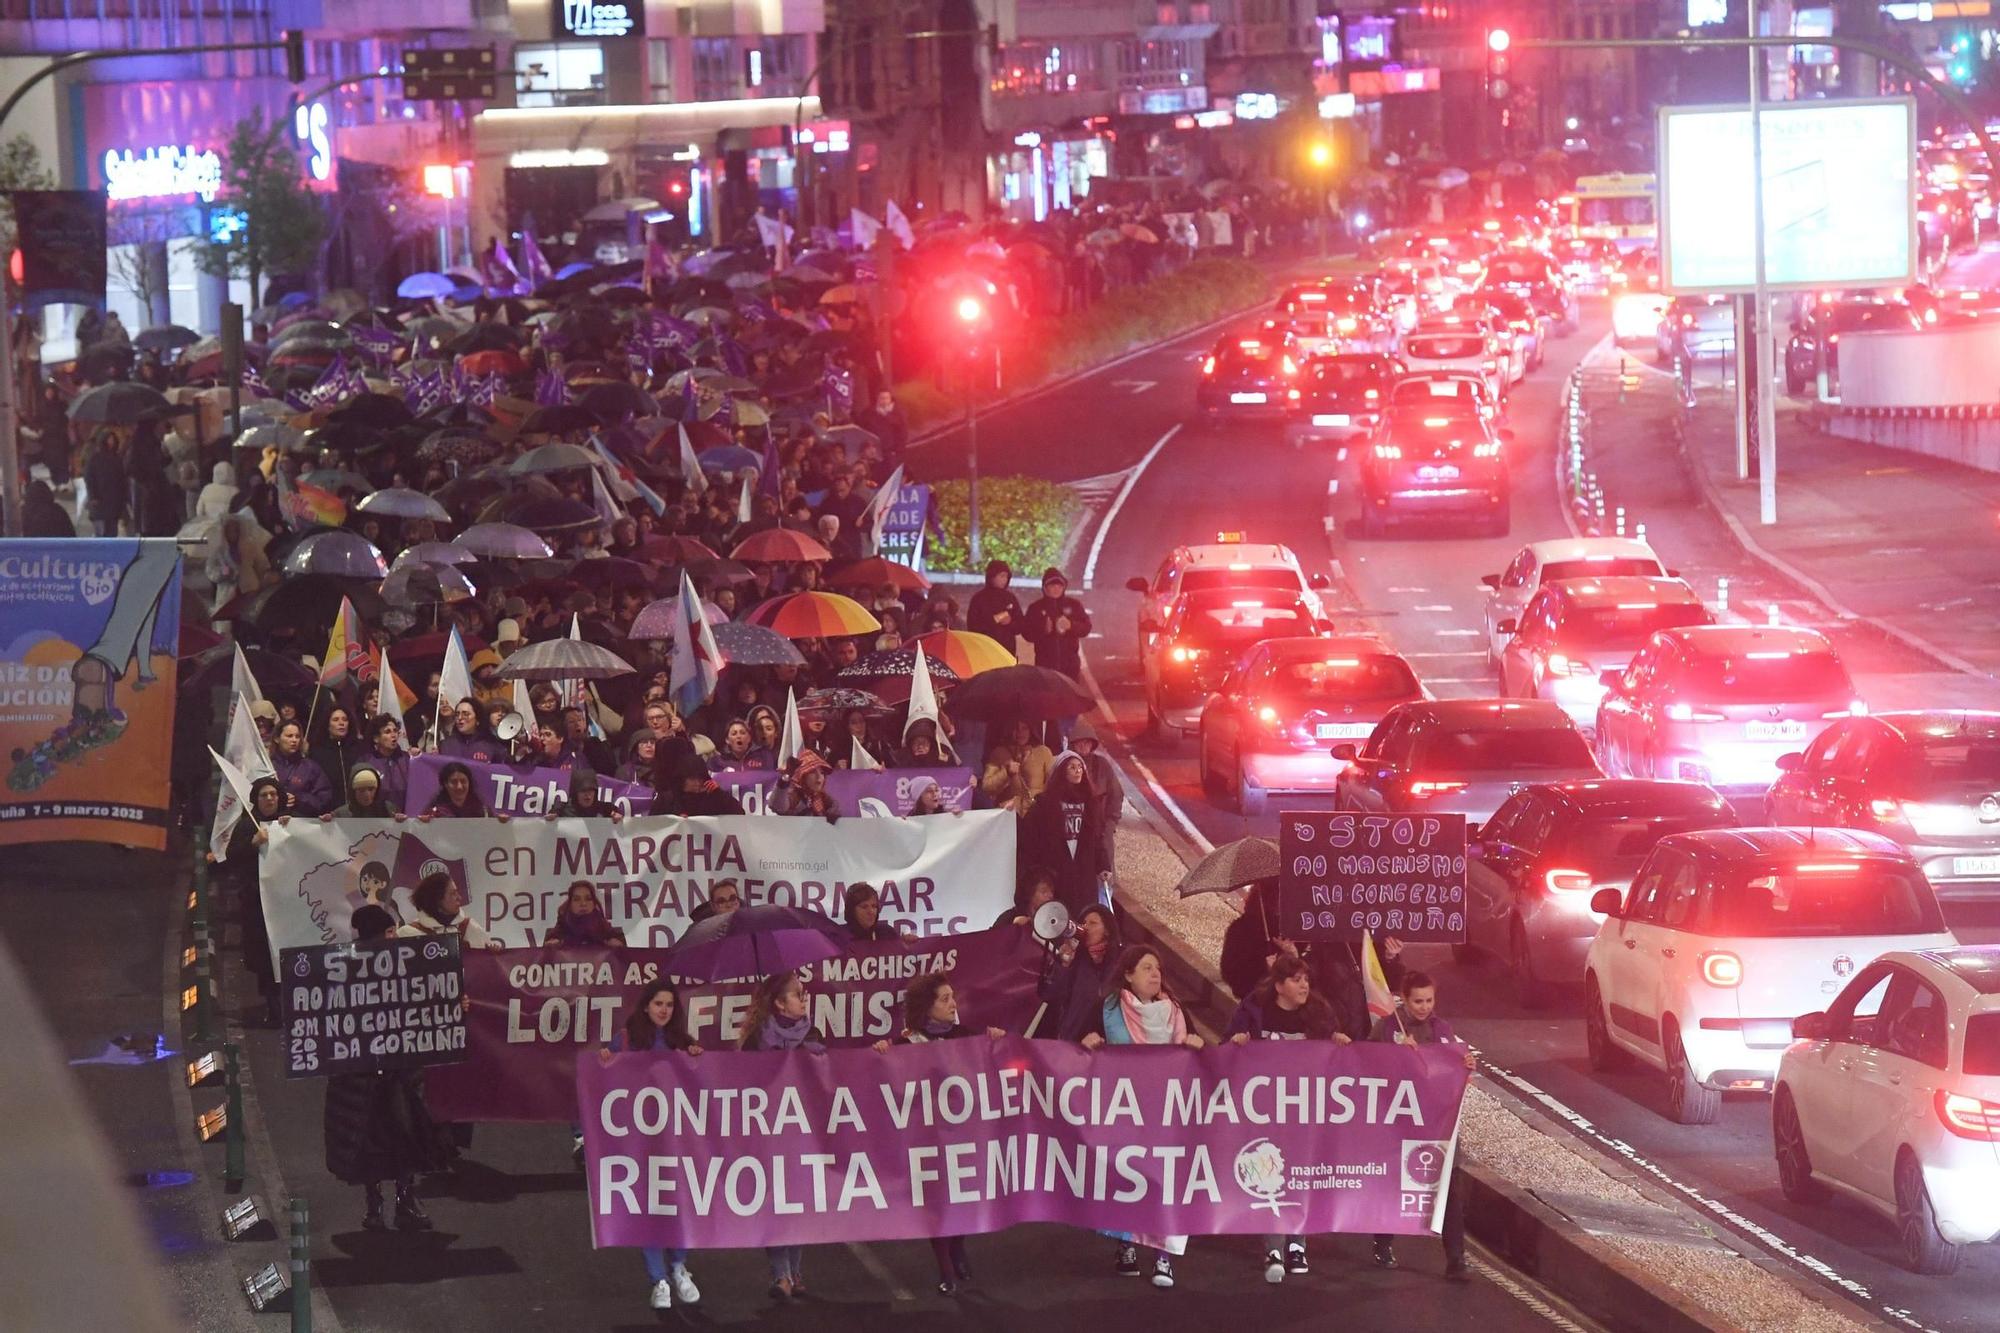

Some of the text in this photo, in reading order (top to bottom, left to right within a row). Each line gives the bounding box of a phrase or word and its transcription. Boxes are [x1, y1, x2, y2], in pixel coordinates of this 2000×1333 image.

[84, 581, 109, 596] bio
[37, 666, 72, 682] DA
[33, 805, 41, 816] 7
[52, 806, 62, 816] 9
[64, 807, 109, 816] marzo
[111, 807, 144, 820] 2025
[1329, 815, 1440, 848] STOP
[484, 833, 748, 877] en MARCHA
[758, 858, 829, 873] feminismo.gal
[1293, 855, 1327, 877] AO
[1312, 883, 1462, 905] NO CONCELLO
[1301, 907, 1463, 931] DA CORUÑA
[324, 946, 416, 982] STOP
[509, 962, 614, 988] CONTRA
[623, 962, 659, 985] AS
[822, 948, 958, 982] MACHISTAS
[293, 972, 459, 1011] AO MACHISMO
[291, 1016, 319, 1037] 8M
[325, 1003, 462, 1037] NO CONCELLO
[507, 996, 623, 1044] LOIT
[291, 1038, 317, 1054] 20
[333, 1025, 466, 1059] DA CORUÑA
[292, 1053, 319, 1071] 25
[600, 1067, 1425, 1137] CONTRA A VIOLENCIA MACHISTA
[600, 1133, 1222, 1217] REVOLTA FEMINISTA
[1291, 1162, 1387, 1176] marcha mundial
[1287, 1176, 1363, 1190] das mulleres
